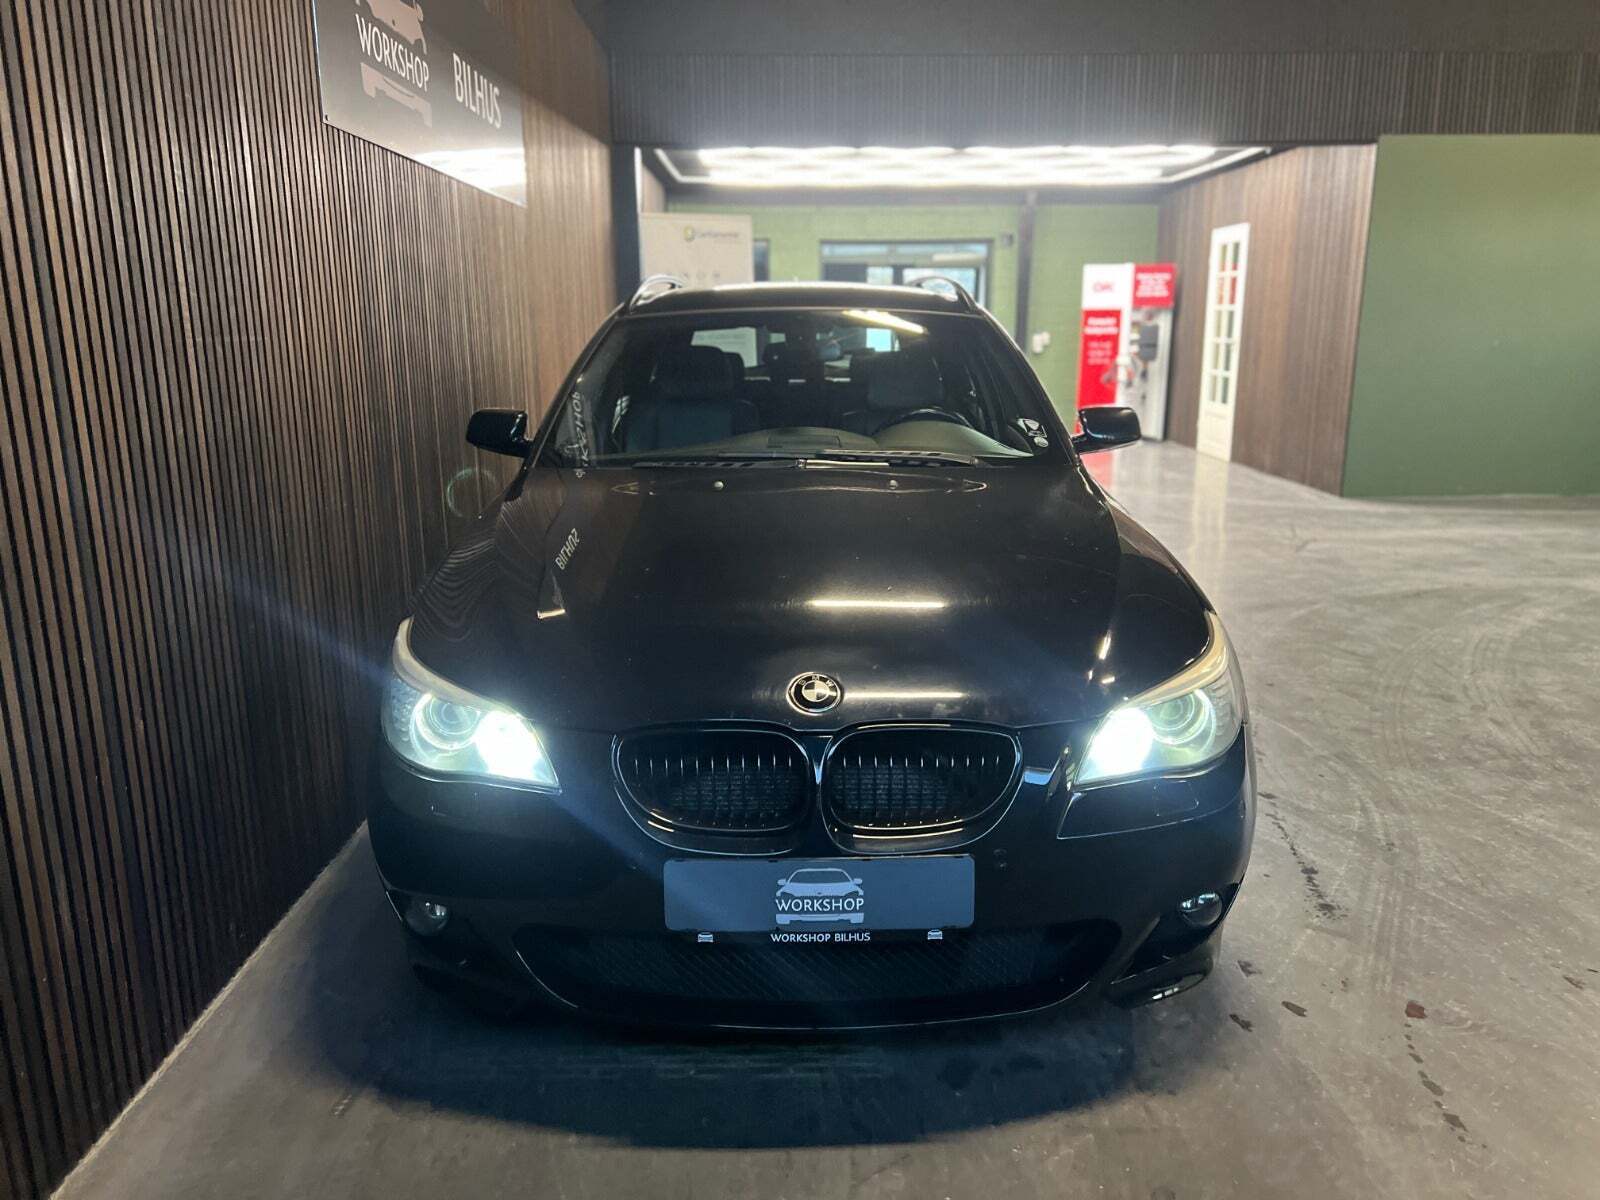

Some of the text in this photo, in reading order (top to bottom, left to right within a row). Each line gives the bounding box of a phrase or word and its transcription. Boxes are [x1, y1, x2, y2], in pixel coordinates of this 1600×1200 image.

[355, 13, 502, 129] WORKSHOP BILHUS
[775, 897, 865, 912] WORKSHOP
[770, 931, 871, 944] WORKSHOP BILHUS
